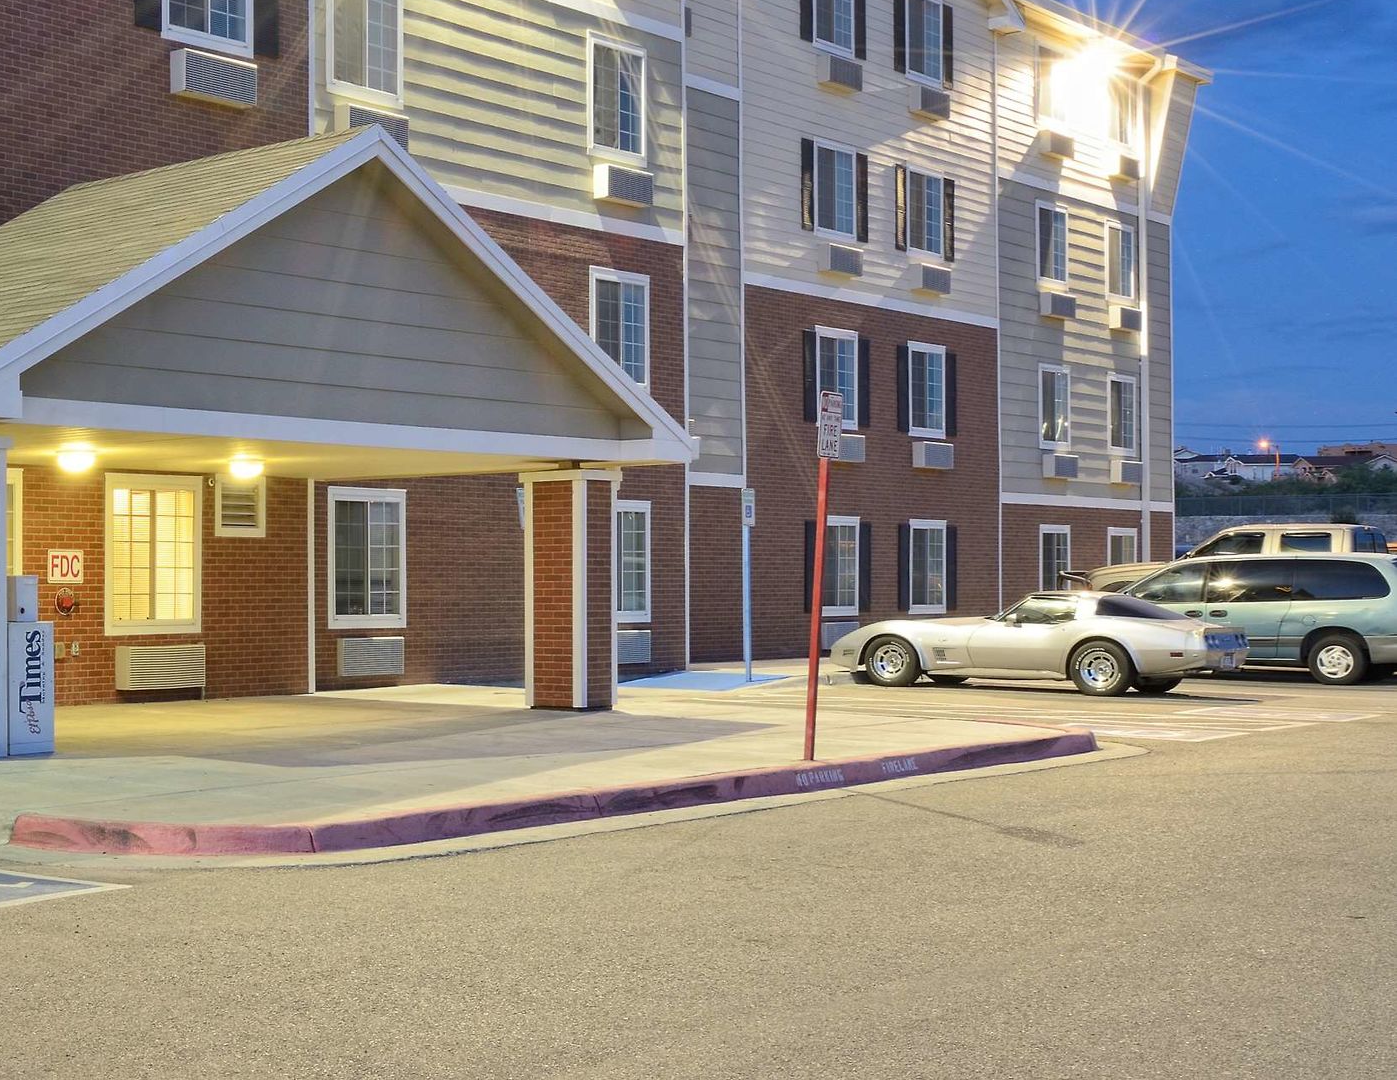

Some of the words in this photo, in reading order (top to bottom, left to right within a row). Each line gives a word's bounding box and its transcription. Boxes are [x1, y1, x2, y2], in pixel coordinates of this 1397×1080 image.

[824, 423, 838, 437] FIRE
[822, 439, 838, 452] LANE
[51, 554, 80, 578] FDC
[19, 630, 42, 713] Times
[796, 773, 808, 786] NO
[808, 769, 845, 784] PARKING
